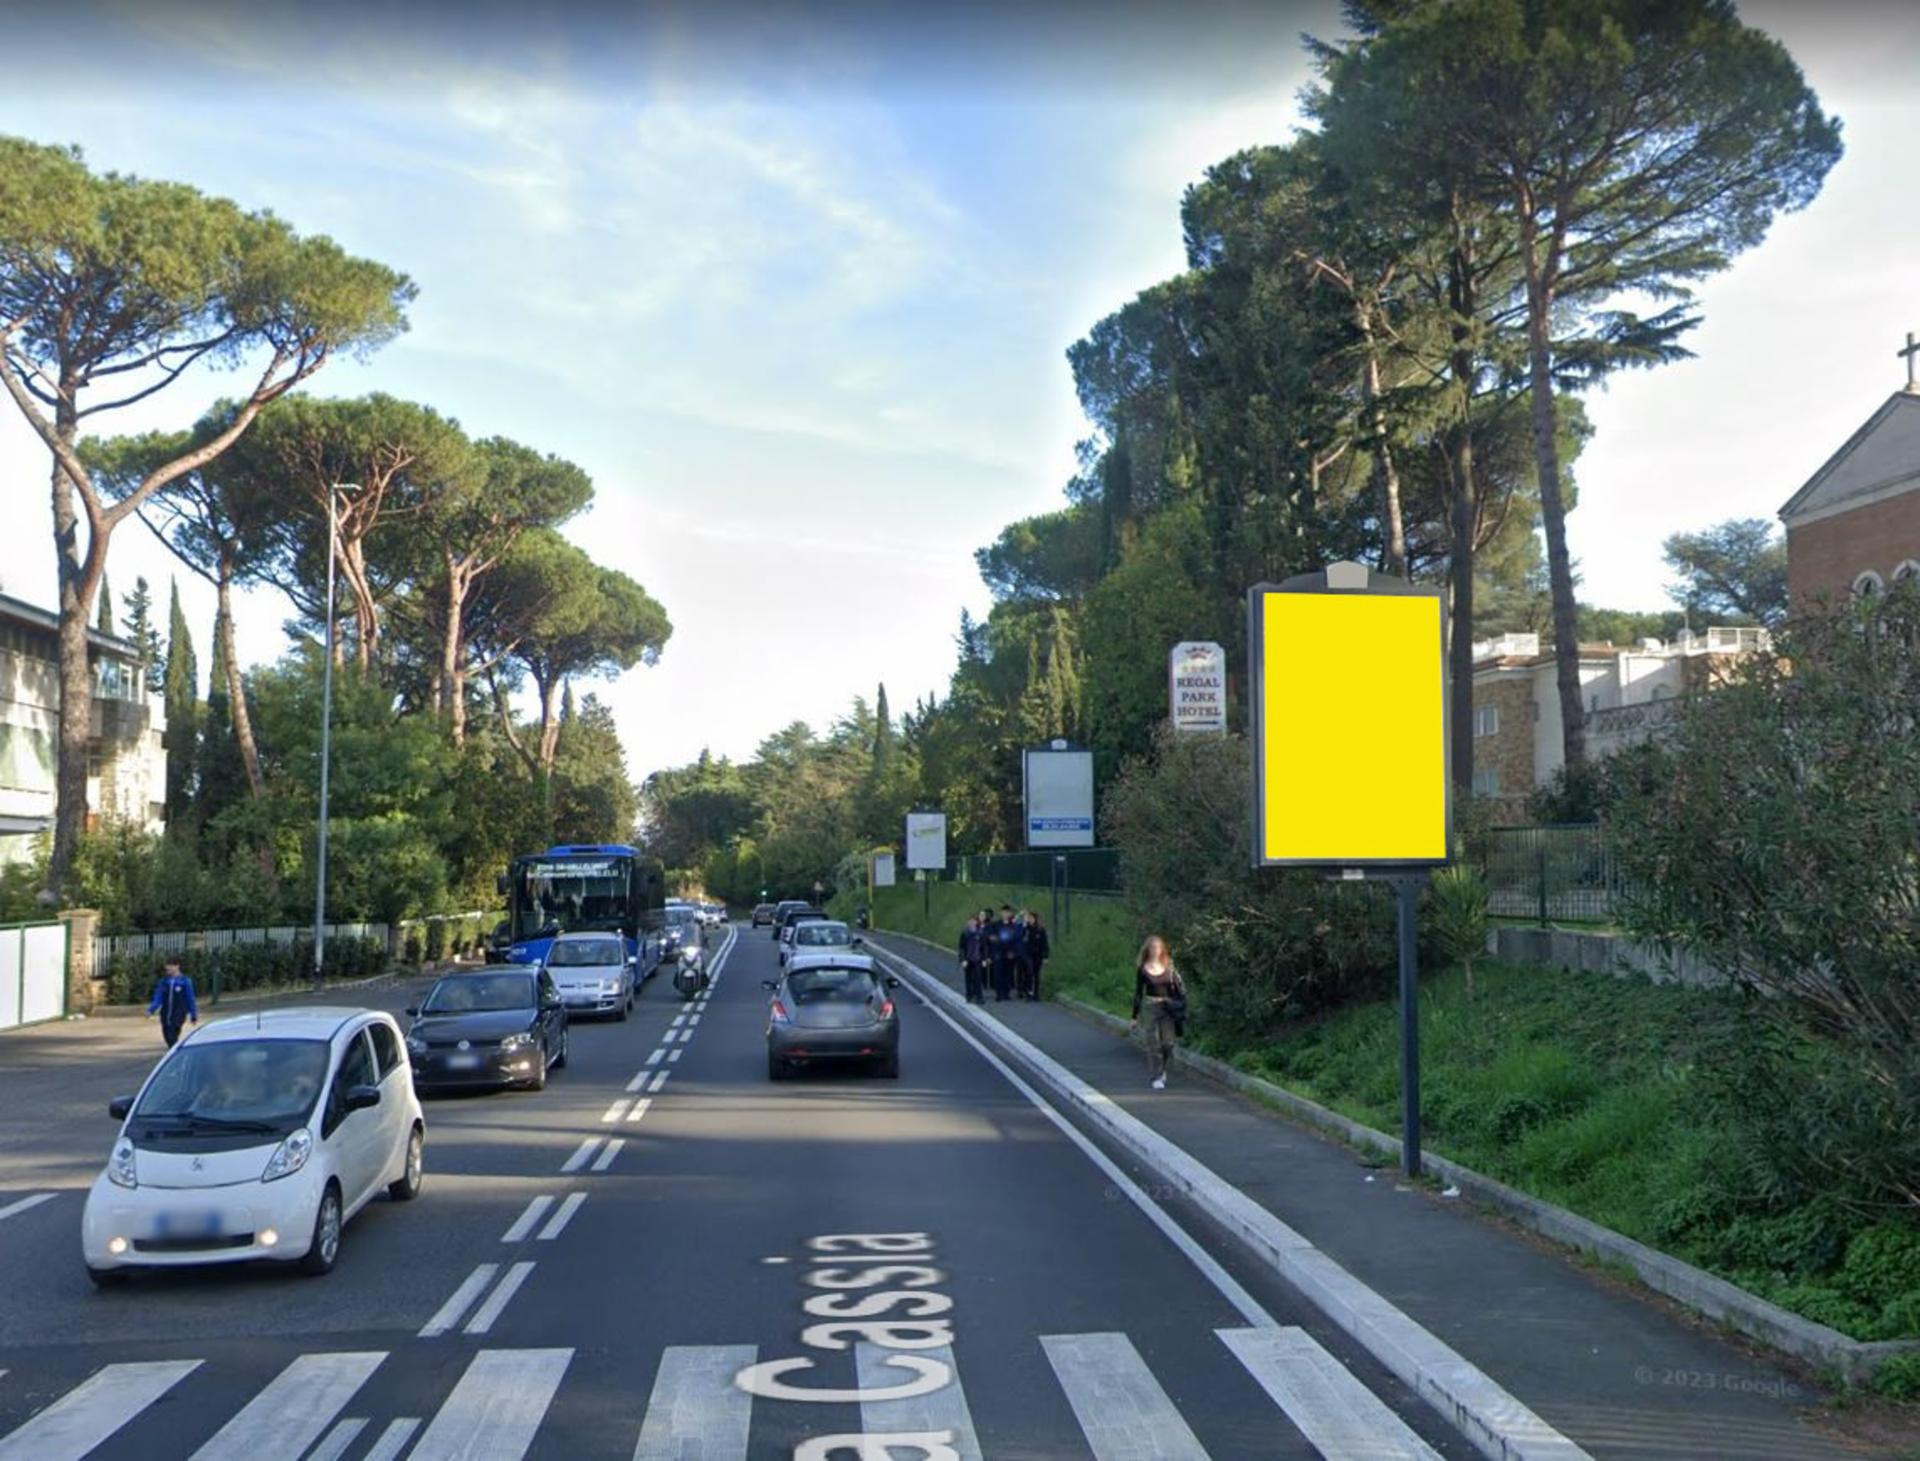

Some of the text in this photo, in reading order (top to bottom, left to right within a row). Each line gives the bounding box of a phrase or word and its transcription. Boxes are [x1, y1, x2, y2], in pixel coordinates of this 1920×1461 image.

[1177, 677, 1219, 687] REGAL
[1182, 692, 1216, 702] PARK
[1178, 706, 1221, 716] HOTEL
